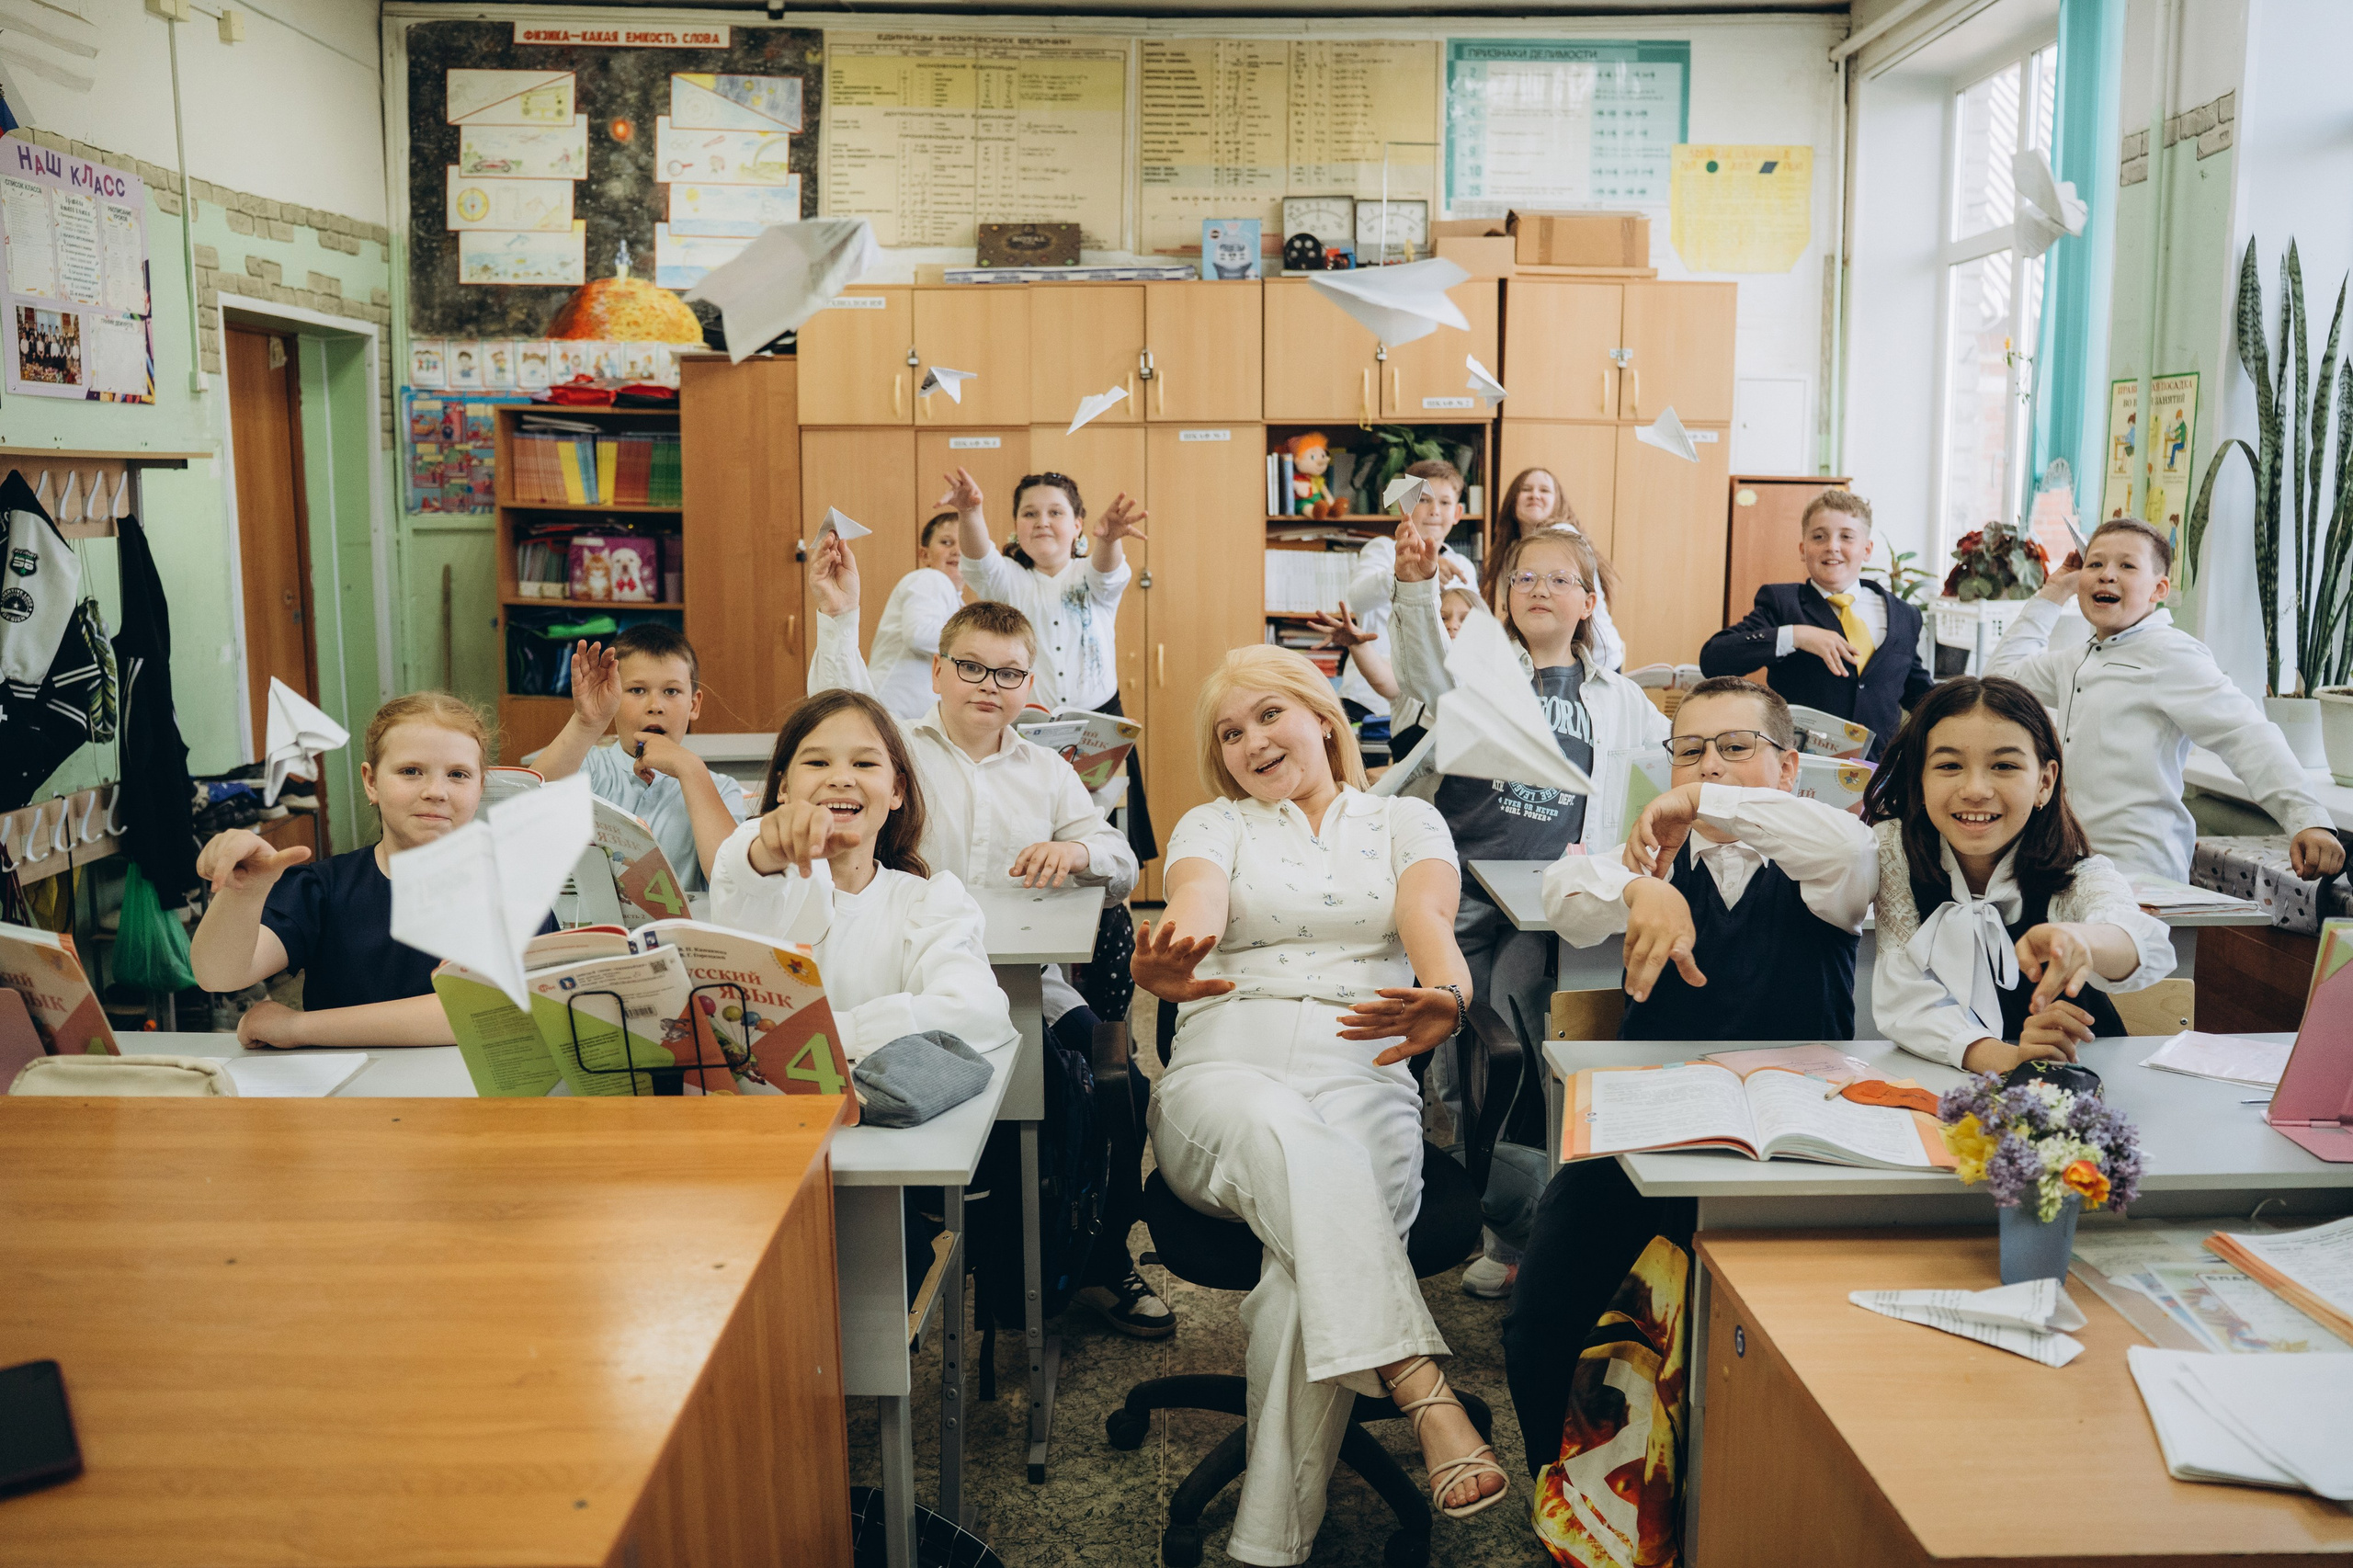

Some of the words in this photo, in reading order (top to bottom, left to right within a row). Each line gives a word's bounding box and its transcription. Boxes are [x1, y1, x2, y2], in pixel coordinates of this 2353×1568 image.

[625, 31, 677, 44] ЕМКОСТЬ
[682, 32, 720, 45] СЛОВА
[1468, 48, 1527, 59] ПРИЗНАКИ
[1529, 49, 1597, 60] ДЕЛИМОСТИ
[17, 144, 62, 178] НАШ
[70, 164, 126, 198] КЛАСС
[1468, 165, 1483, 178] 10
[5, 178, 24, 190] СПИСОК
[24, 184, 42, 194] КЛАССА
[2161, 380, 2193, 392] ПОСАДКА
[1082, 736, 1108, 749] ЗЫК
[1079, 759, 1114, 788] 4
[1504, 798, 1522, 809] EVER
[1535, 806, 1560, 817] NEVER
[1505, 806, 1521, 816] GIRL
[597, 831, 642, 851] ЯЗЫК
[642, 869, 684, 915] 4
[688, 967, 763, 987] УССКИЙ
[719, 986, 795, 1010] ЯЗЫК
[786, 1031, 848, 1096] 4
